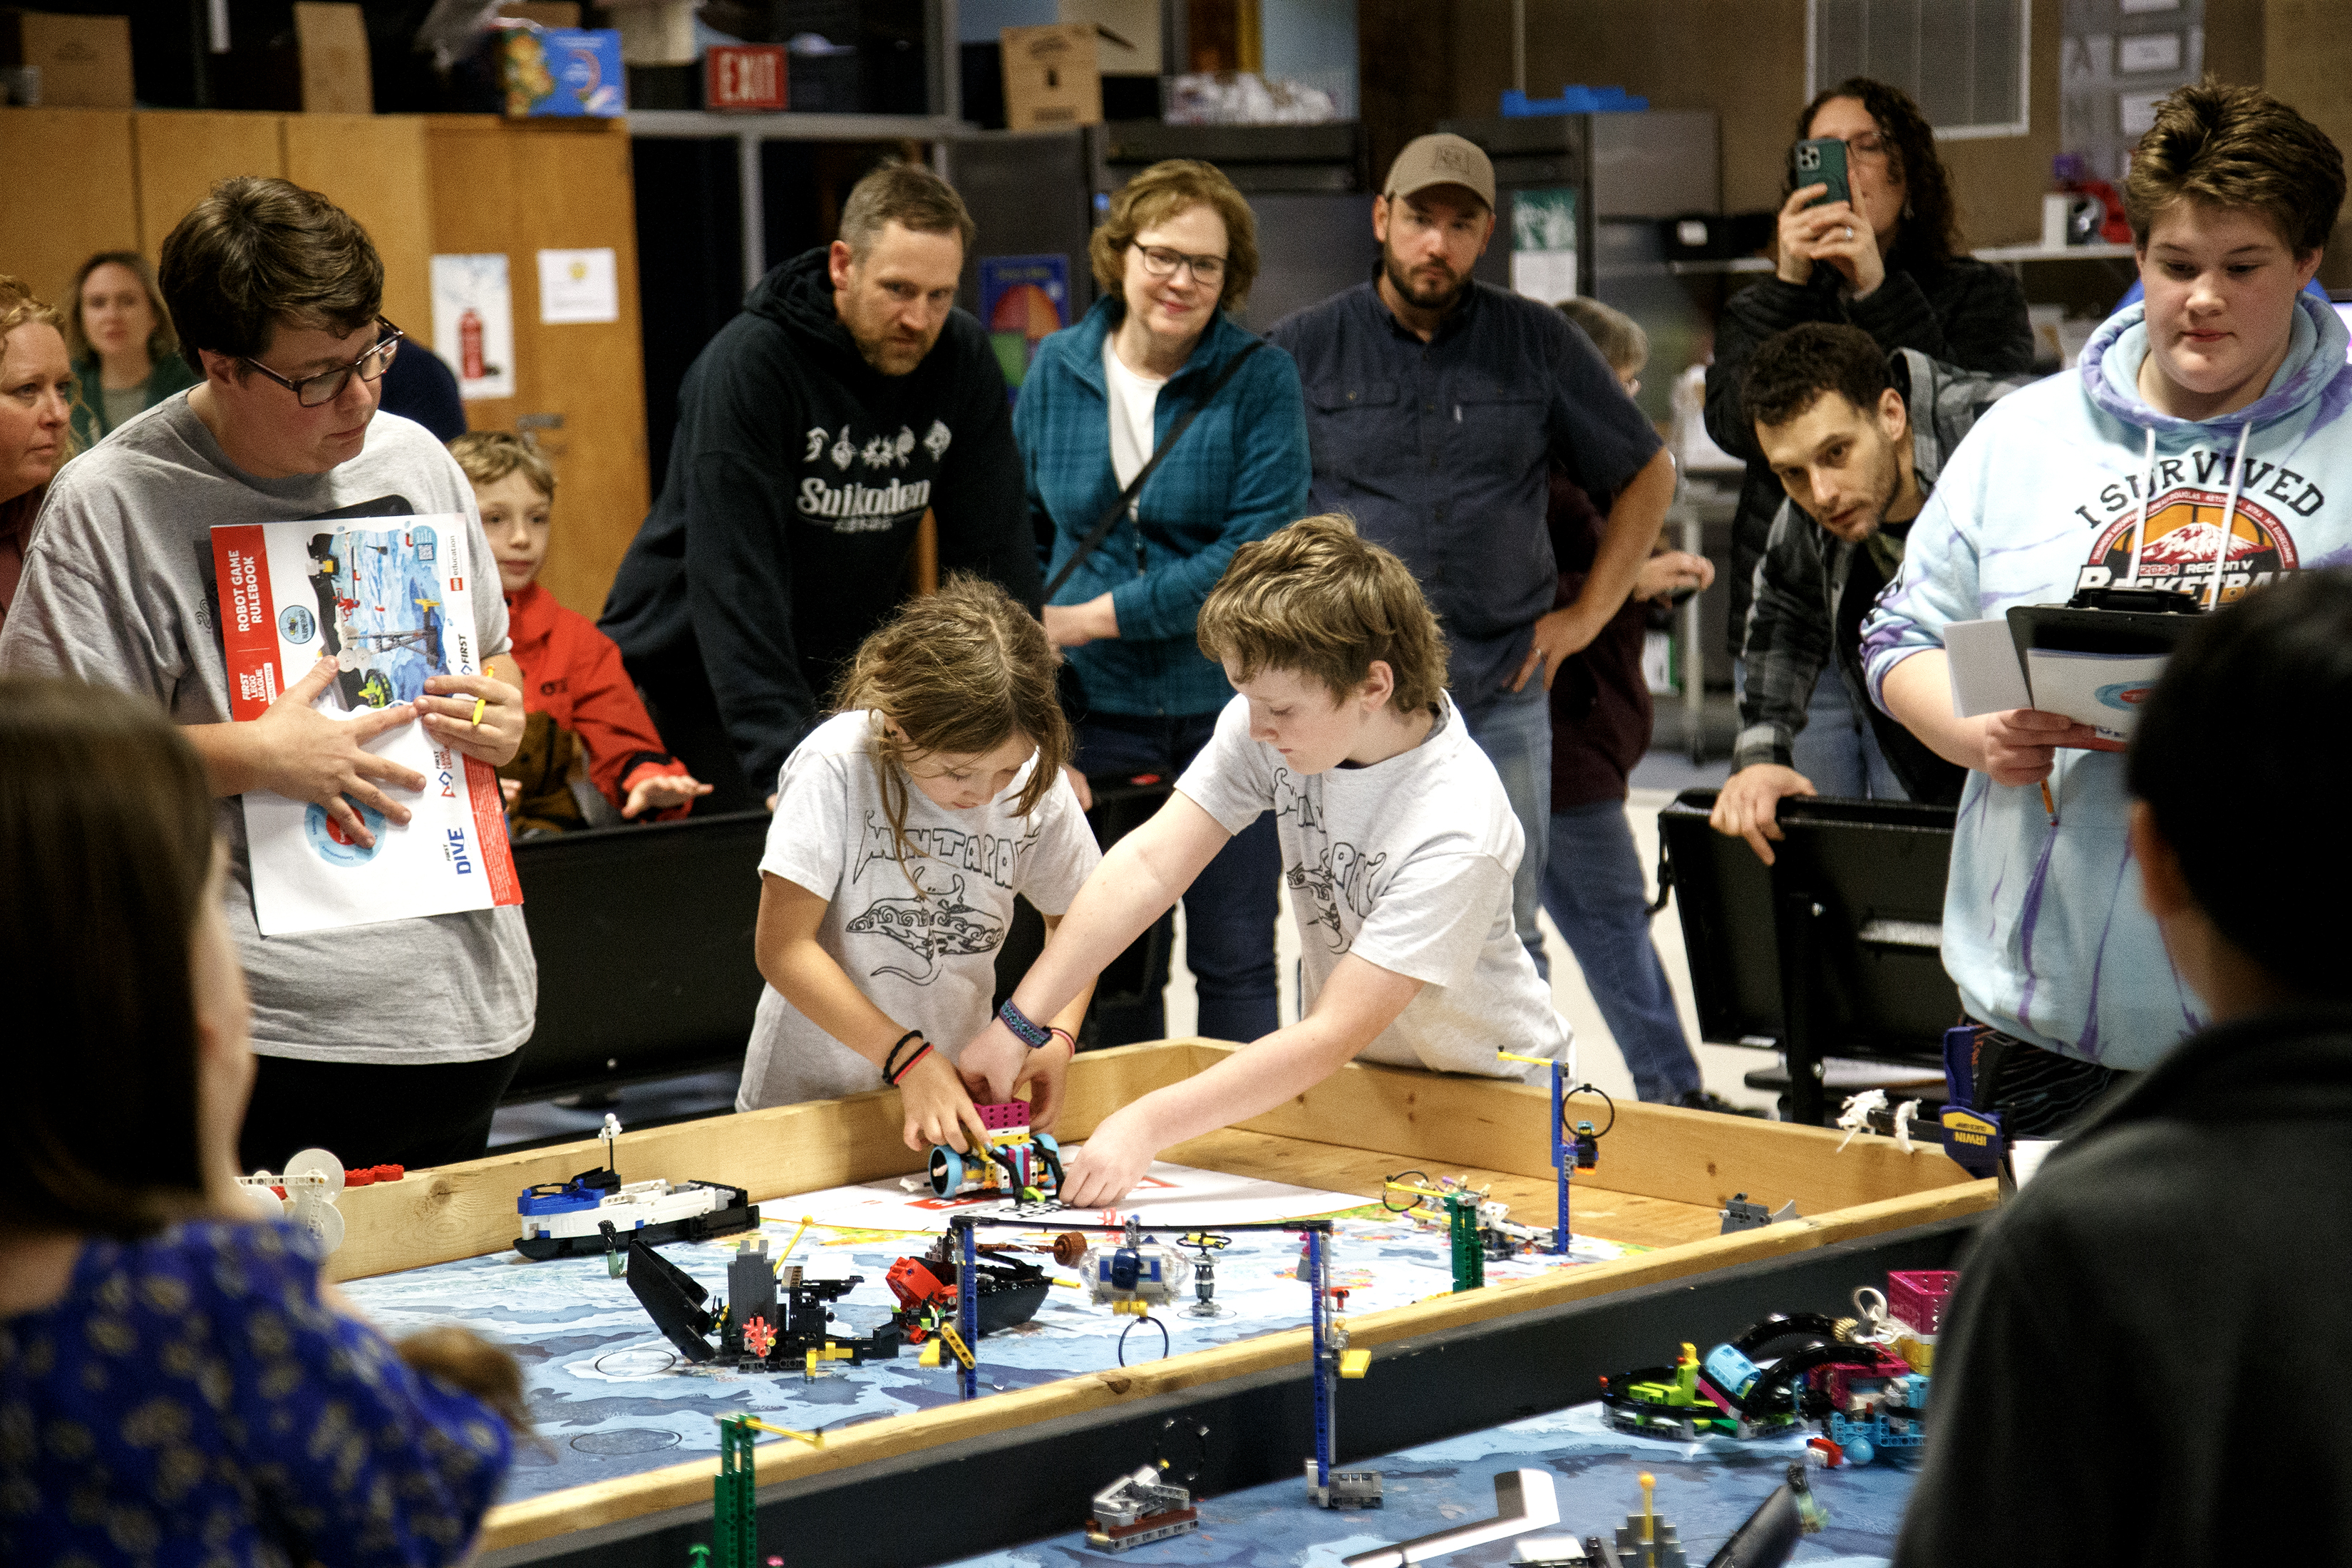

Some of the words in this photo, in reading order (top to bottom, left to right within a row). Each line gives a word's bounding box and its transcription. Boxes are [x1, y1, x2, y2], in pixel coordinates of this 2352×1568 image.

[718, 52, 775, 100] EXIT
[796, 477, 931, 517] Suikoden
[2075, 505, 2101, 529] I
[2100, 450, 2324, 517] SURVIVED
[228, 550, 243, 586] GAME
[2139, 563, 2180, 576] 2024
[243, 556, 262, 624] RULEBOOK
[233, 588, 250, 632] ROBOT
[458, 634, 469, 664] FIRST
[239, 673, 252, 701] FIRST
[249, 674, 258, 698] LEGO
[255, 669, 266, 701] LEAGUE
[447, 827, 472, 875] DIVE
[1954, 1131, 1987, 1146] IRWIN
